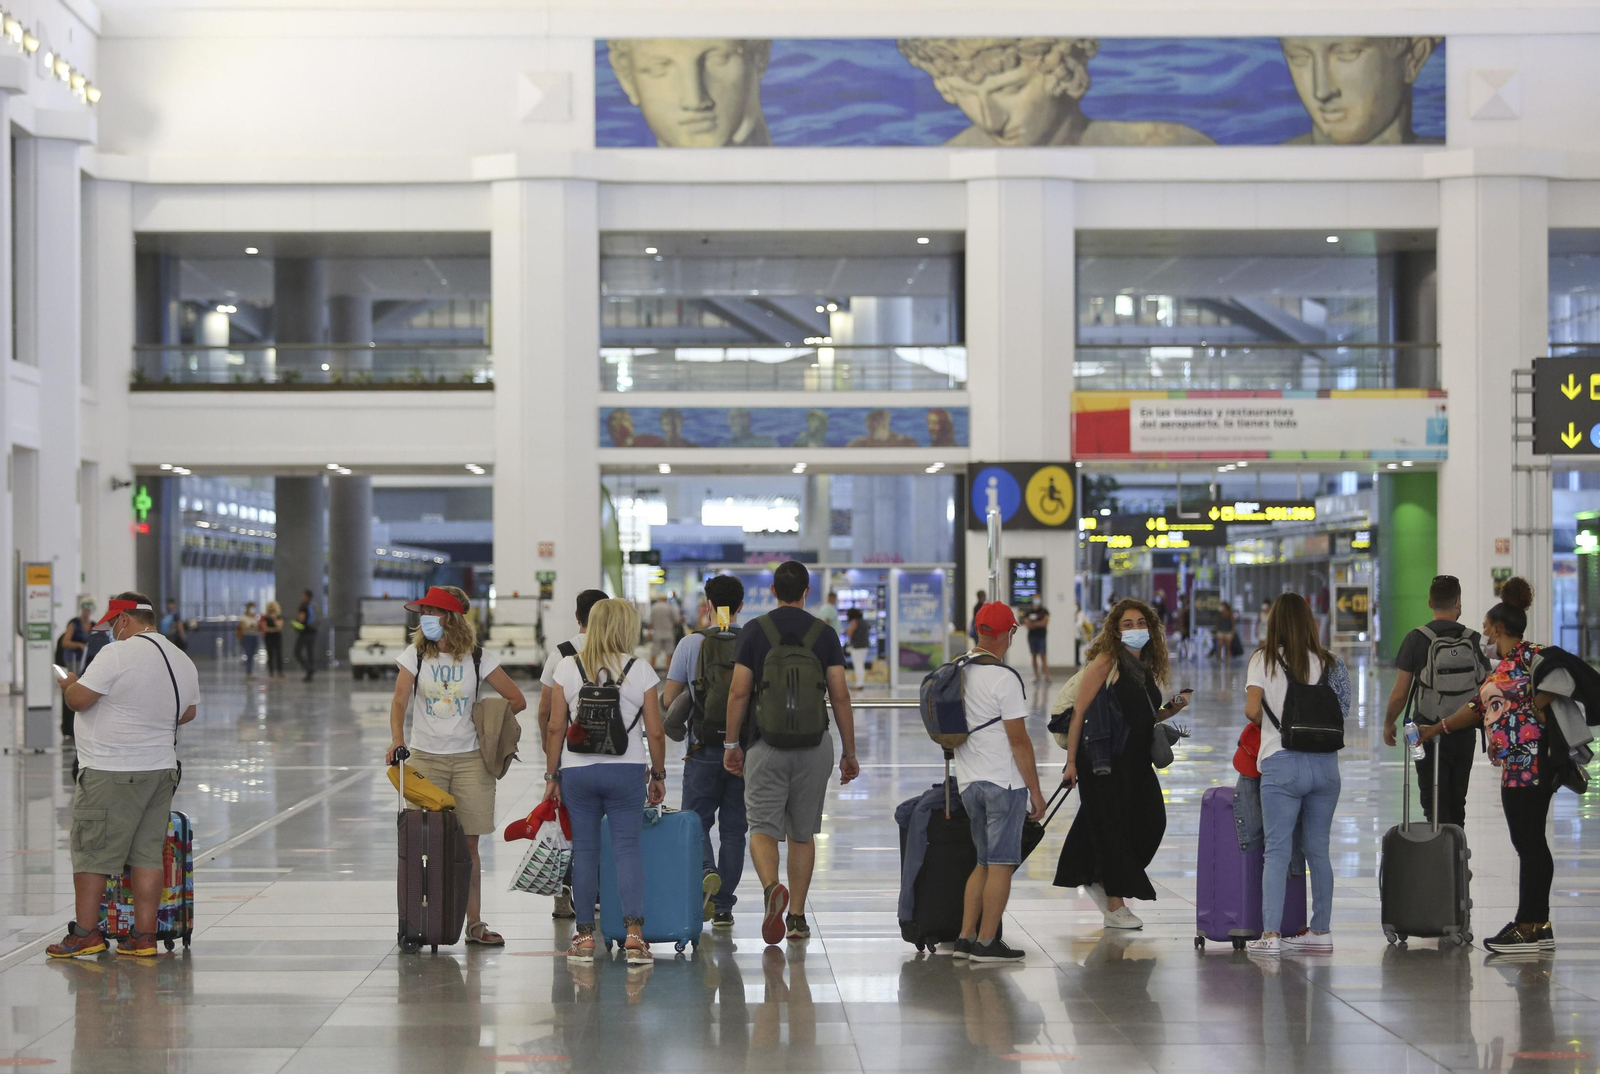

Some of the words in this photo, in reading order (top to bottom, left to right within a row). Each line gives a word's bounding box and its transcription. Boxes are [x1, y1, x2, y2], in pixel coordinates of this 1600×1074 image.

[1140, 407, 1154, 417] En
[1156, 407, 1171, 417] las
[1174, 407, 1214, 417] tiendas
[1216, 409, 1223, 419] y
[1225, 407, 1294, 417] restaurantes
[1140, 419, 1157, 429] del
[1237, 419, 1270, 429] tienes
[1273, 419, 1298, 429] todo
[430, 664, 464, 683] YOU
[425, 697, 469, 716] GAT
